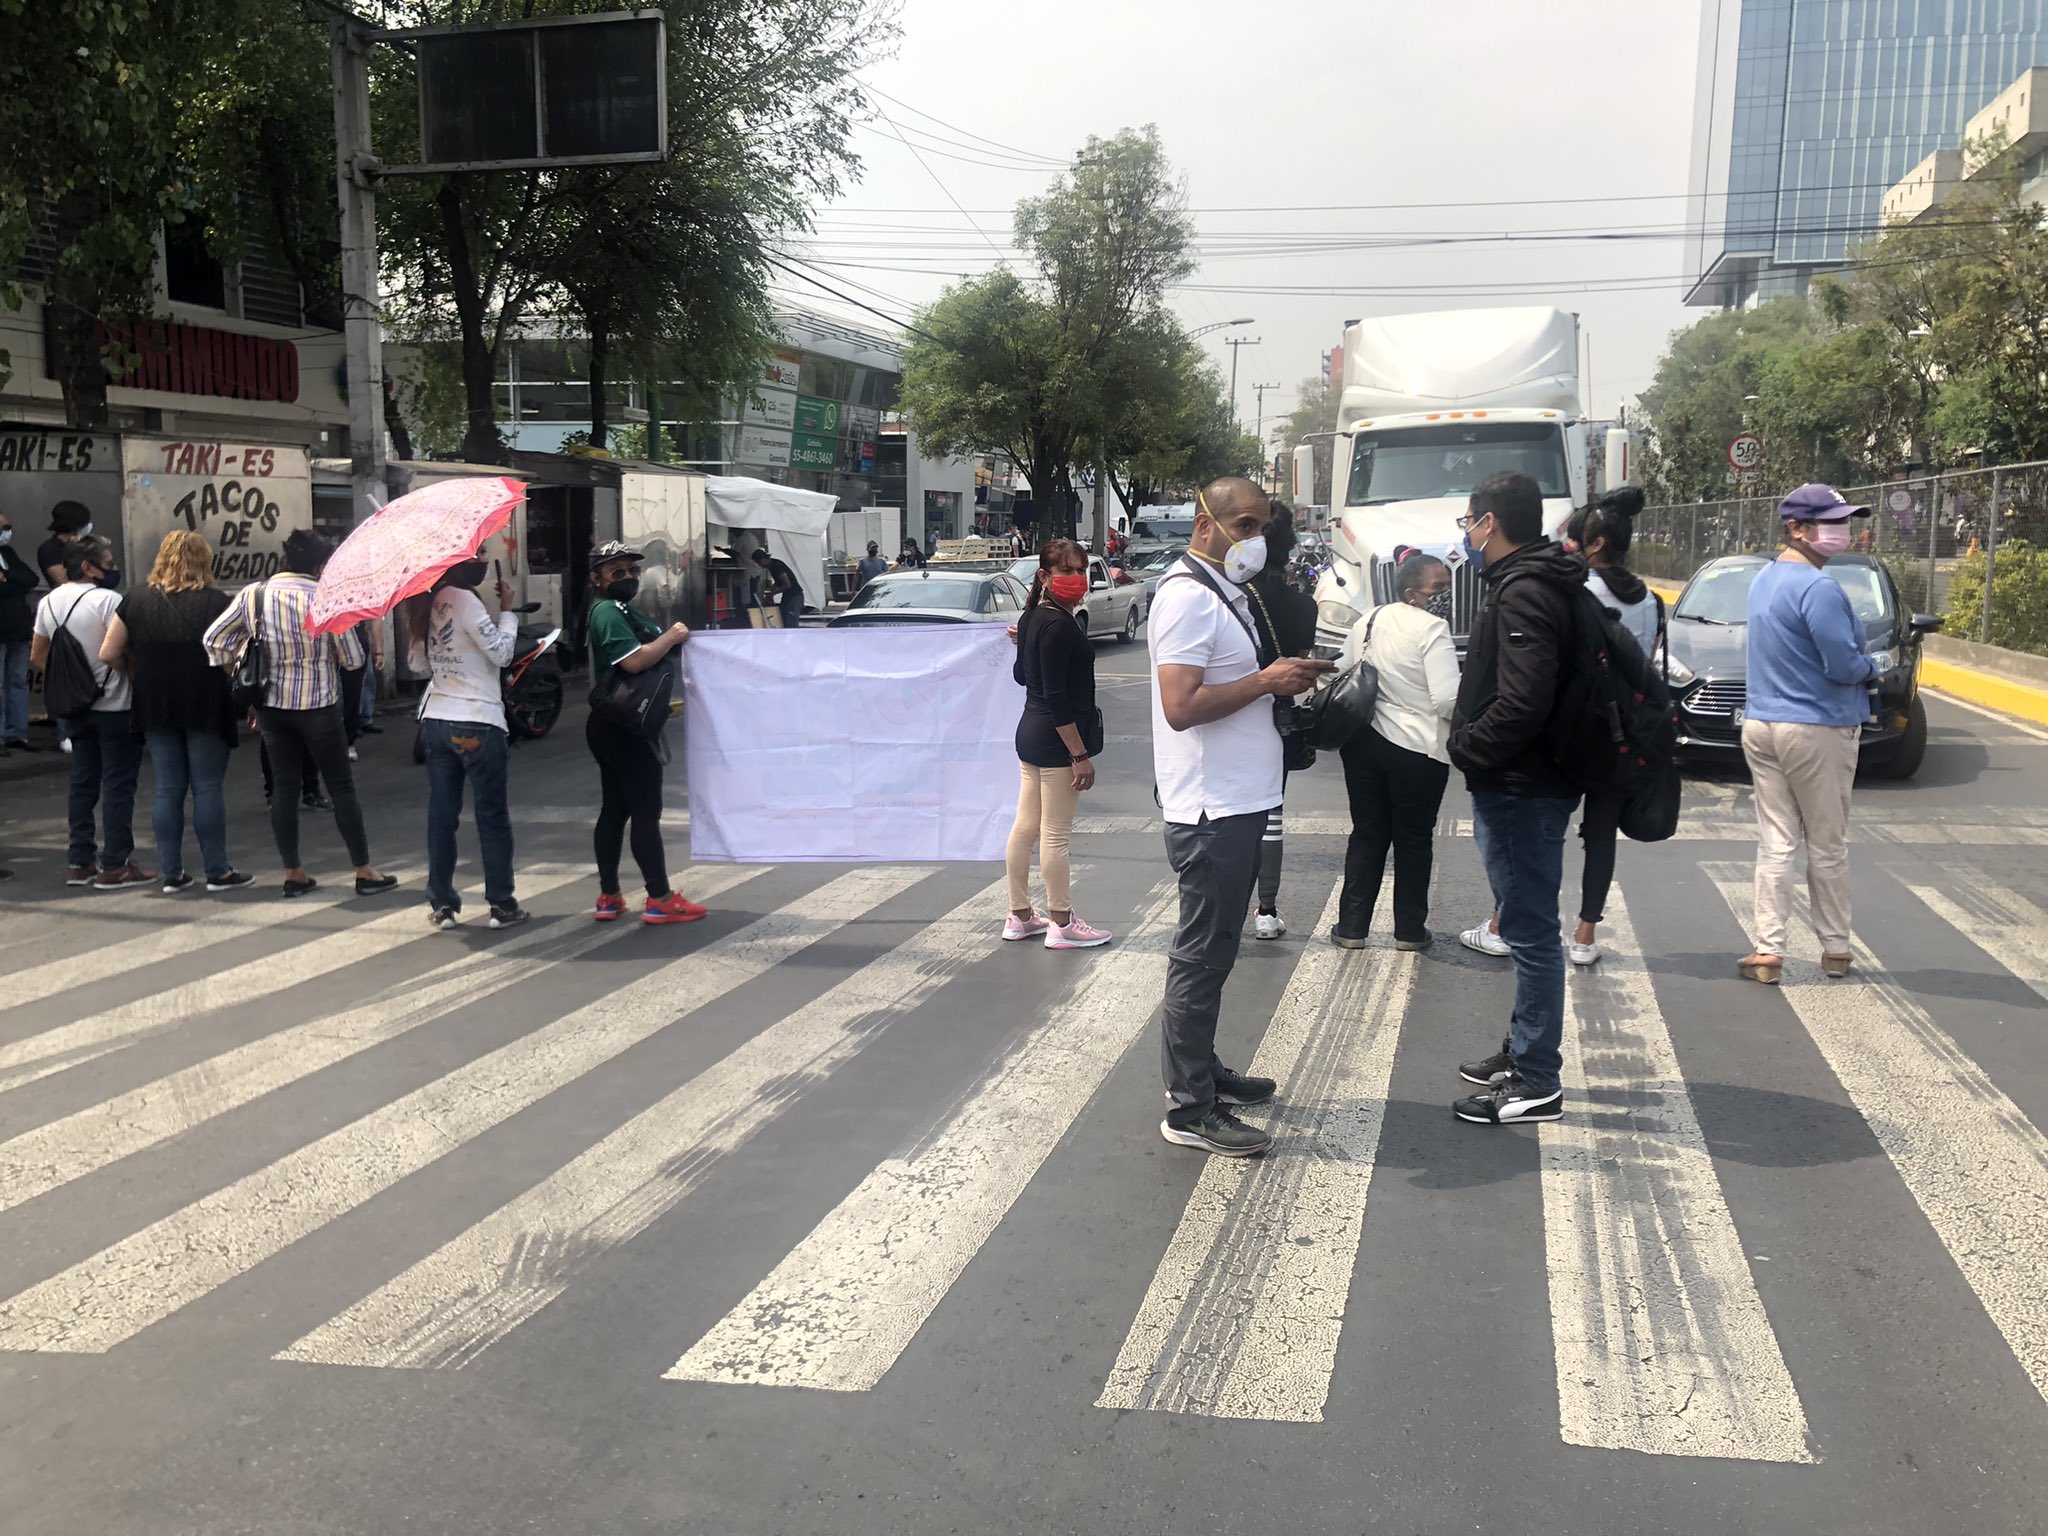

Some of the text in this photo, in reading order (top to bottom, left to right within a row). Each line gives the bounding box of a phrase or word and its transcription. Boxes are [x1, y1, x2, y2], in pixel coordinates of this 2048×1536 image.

[1736, 442, 1757, 458] 50
[173, 480, 280, 532] TACOS
[220, 520, 252, 547] DE
